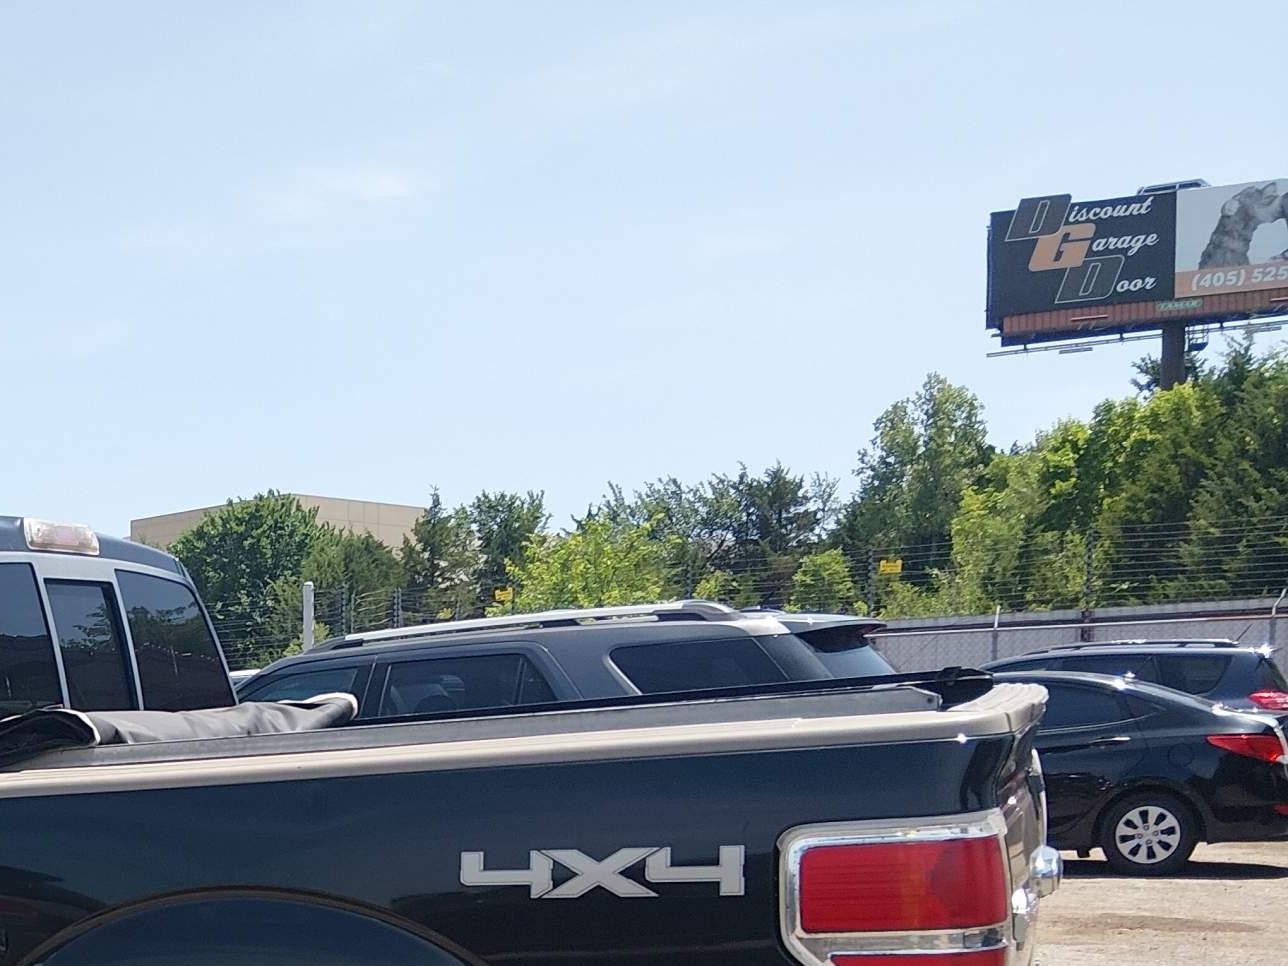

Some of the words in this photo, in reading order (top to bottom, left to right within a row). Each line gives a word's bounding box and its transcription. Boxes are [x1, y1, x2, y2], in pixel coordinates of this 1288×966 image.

[1005, 193, 1155, 242] Discount
[1028, 223, 1160, 273] Garage
[1055, 254, 1157, 305] Door
[1191, 269, 1246, 292] (405)
